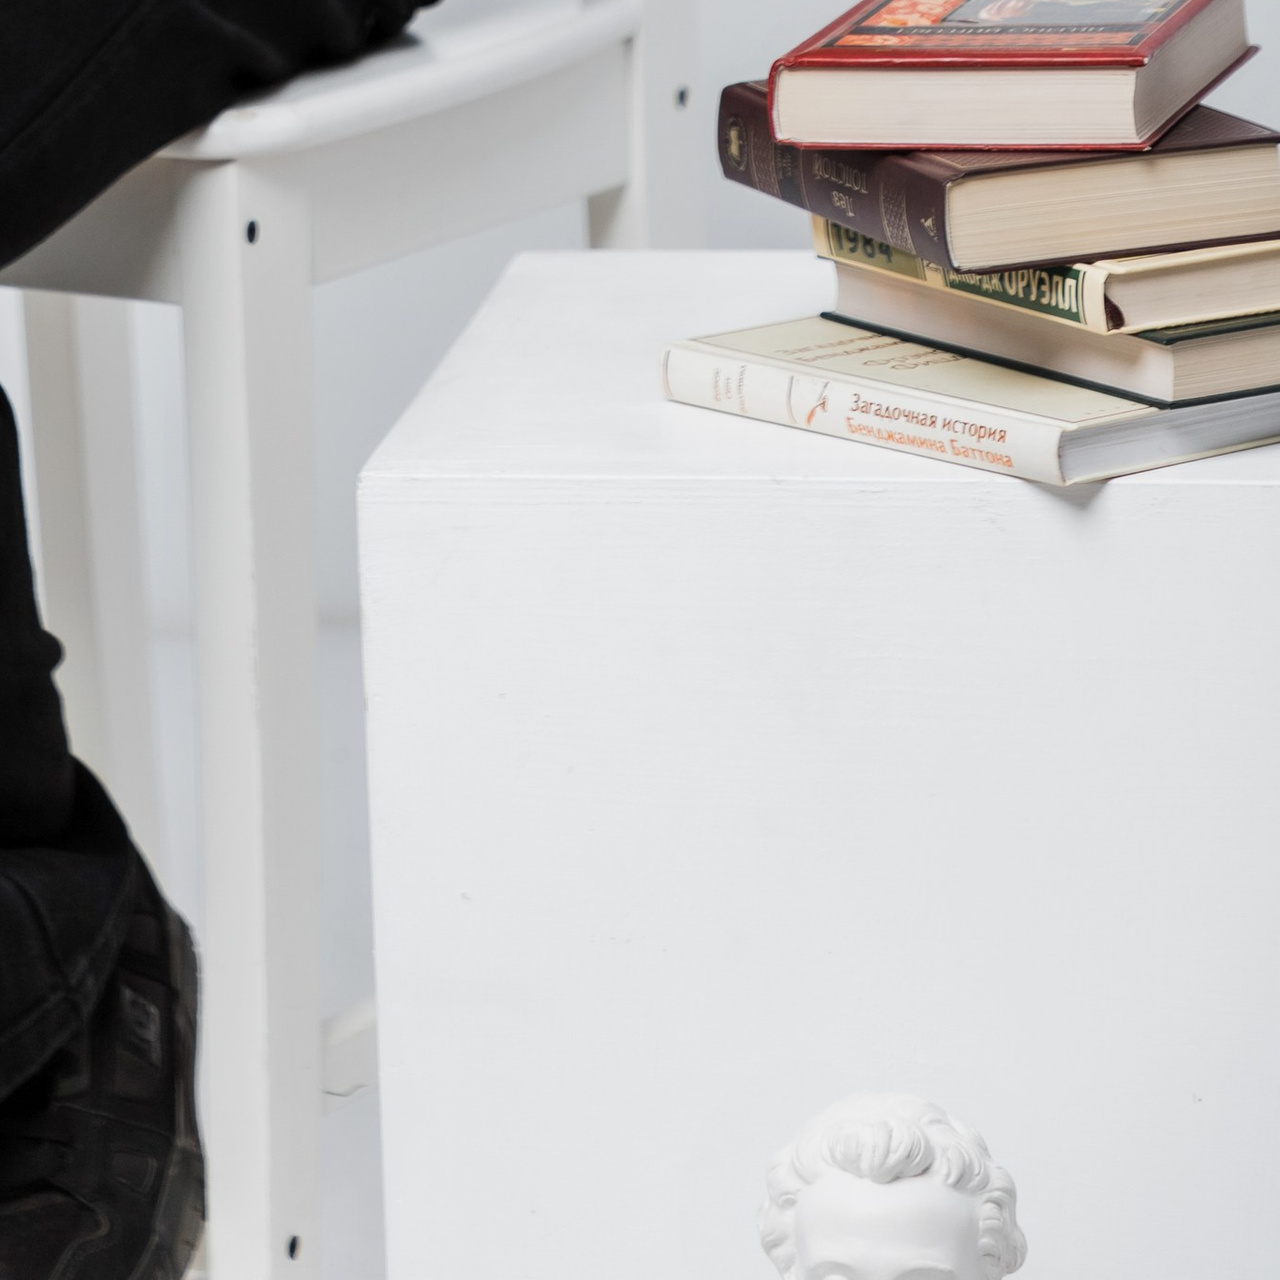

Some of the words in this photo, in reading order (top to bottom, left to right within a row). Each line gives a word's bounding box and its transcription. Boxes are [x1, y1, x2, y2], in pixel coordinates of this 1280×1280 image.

[832, 190, 855, 217] Лев
[1003, 268, 1078, 313] ОРУЭЛЛ
[845, 416, 947, 453] Бенджамина
[949, 438, 1014, 468] Баттона
[850, 393, 938, 428] Загадочная
[942, 417, 1007, 444] история
